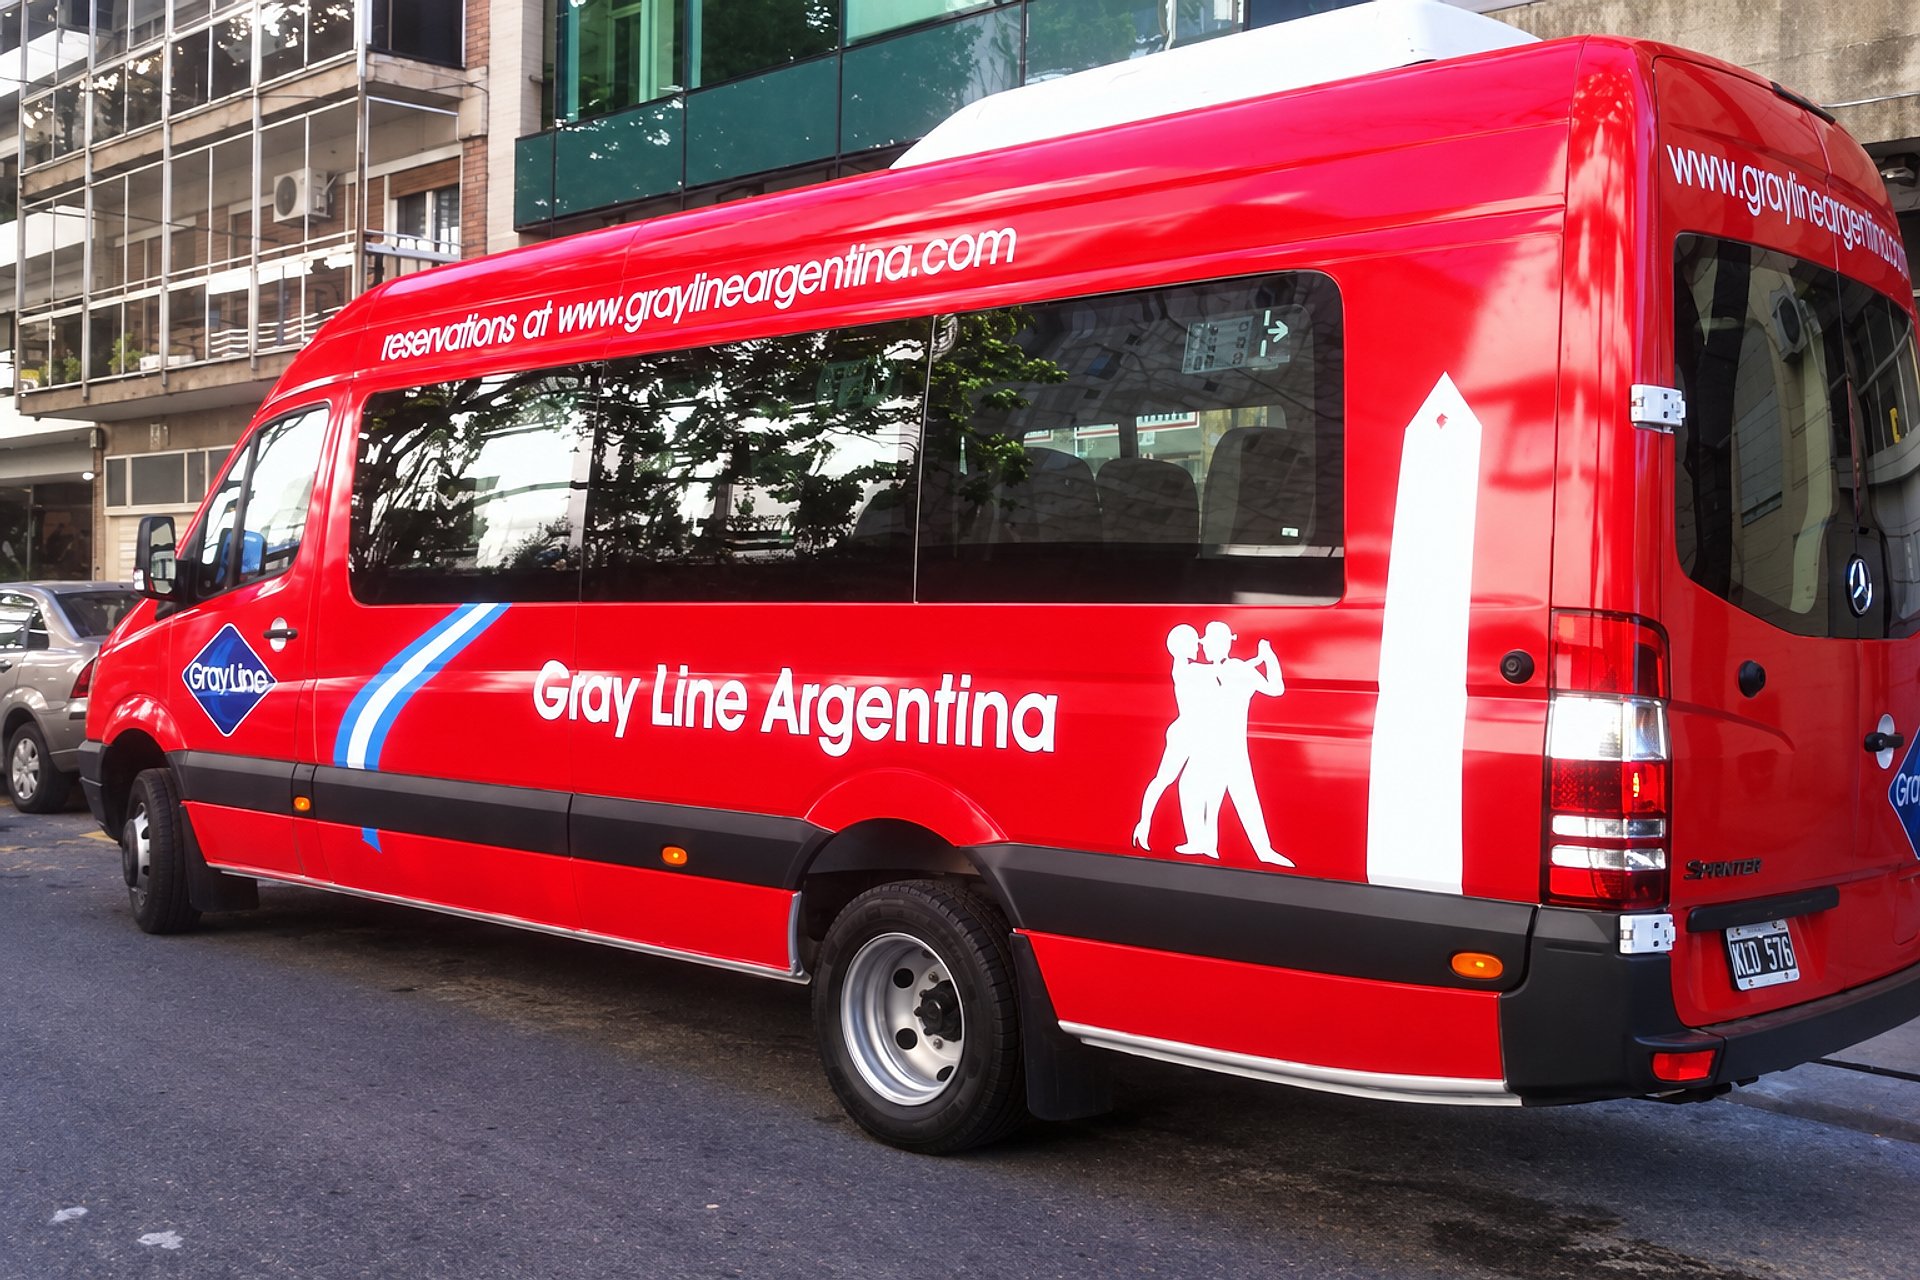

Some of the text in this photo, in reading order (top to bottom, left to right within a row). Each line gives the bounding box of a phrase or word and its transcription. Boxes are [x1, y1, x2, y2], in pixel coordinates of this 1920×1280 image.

[380, 226, 1017, 362] reservations at www.graylineargentina.com
[533, 660, 1059, 758] Gray Line Argentina
[1896, 773, 1920, 807] Gra
[1731, 936, 1794, 976] KLD 576
